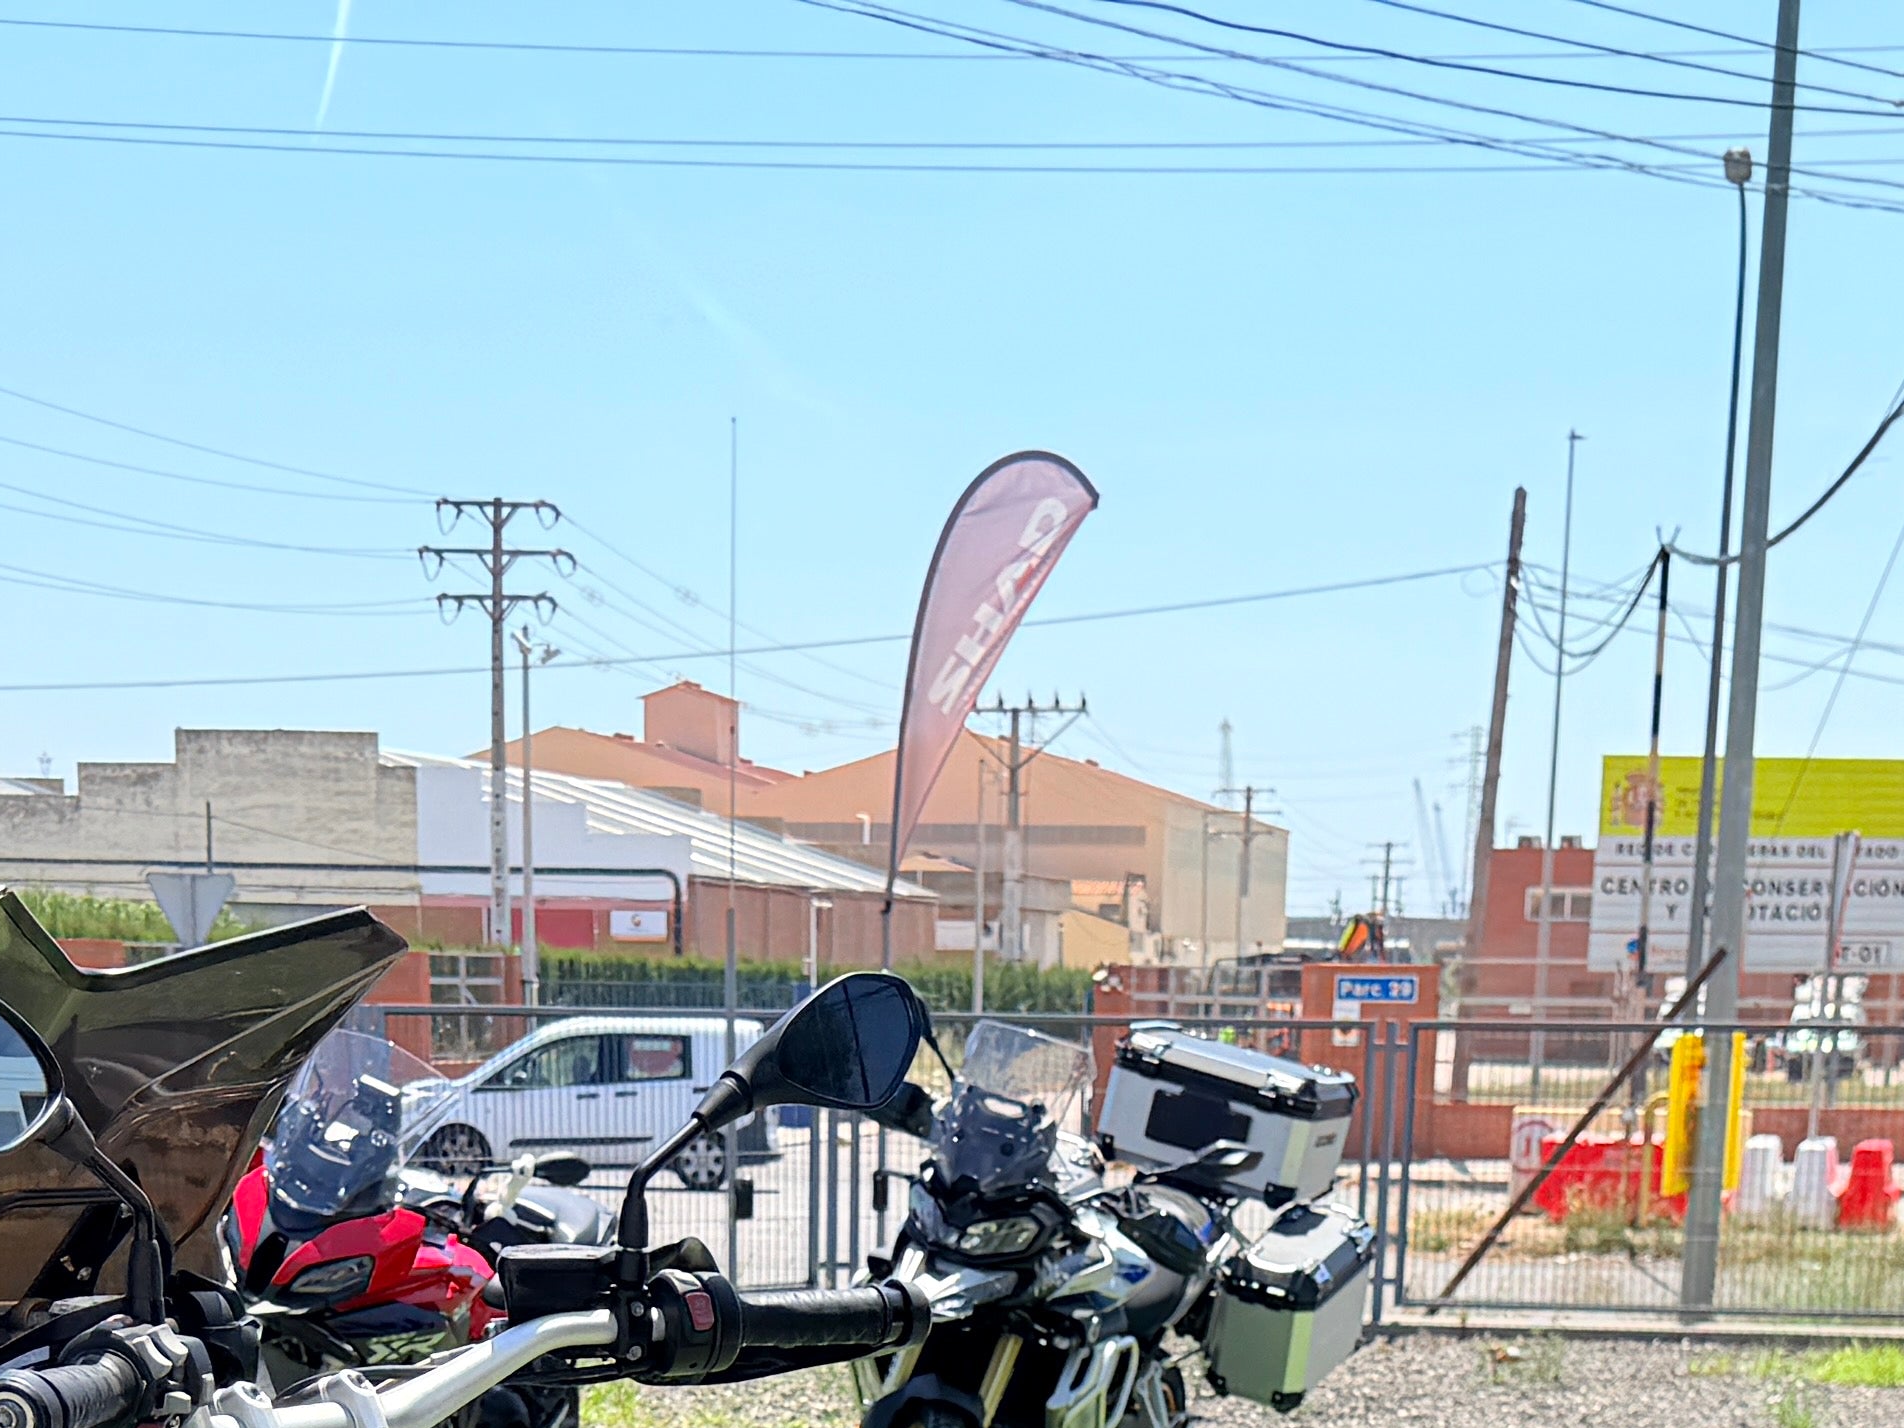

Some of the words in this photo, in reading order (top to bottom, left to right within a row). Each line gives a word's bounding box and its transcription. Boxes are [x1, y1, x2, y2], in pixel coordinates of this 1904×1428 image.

[928, 497, 1068, 715] SHAD
[1600, 876, 1689, 896] CENTRO
[1665, 903, 1678, 921] Y
